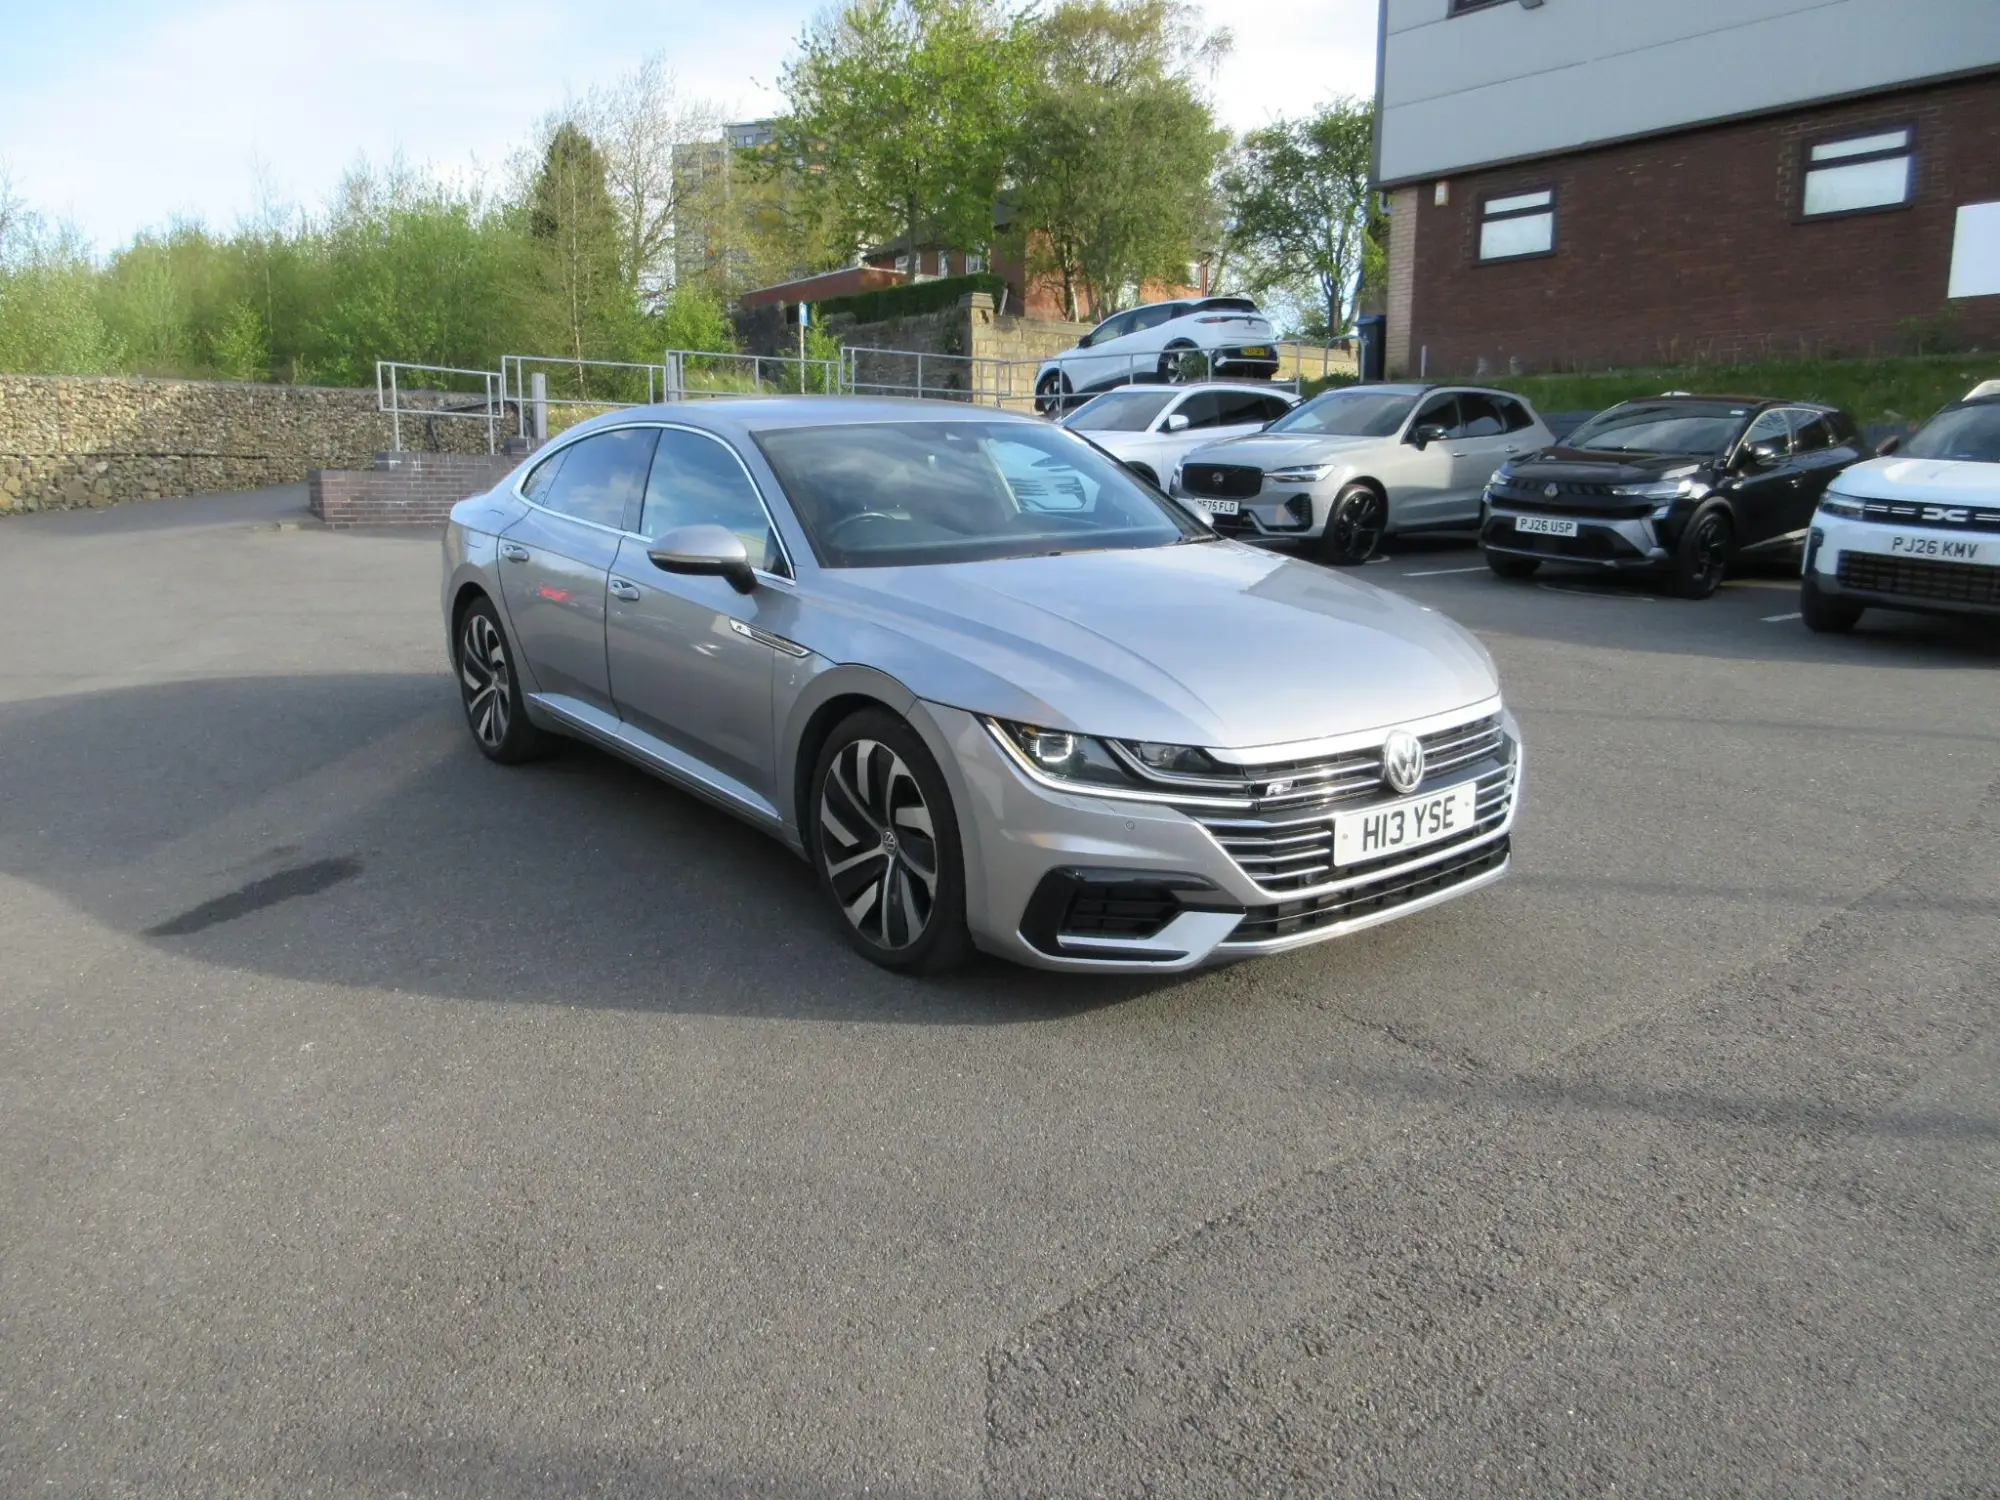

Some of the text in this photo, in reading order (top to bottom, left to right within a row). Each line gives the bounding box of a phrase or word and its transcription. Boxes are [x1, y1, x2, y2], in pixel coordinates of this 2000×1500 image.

[1218, 501, 1236, 513] FLD
[1520, 518, 1573, 533] PJ26 USP
[1892, 536, 1979, 559] PJ26 KMV
[1362, 794, 1456, 852] H13 YSE
